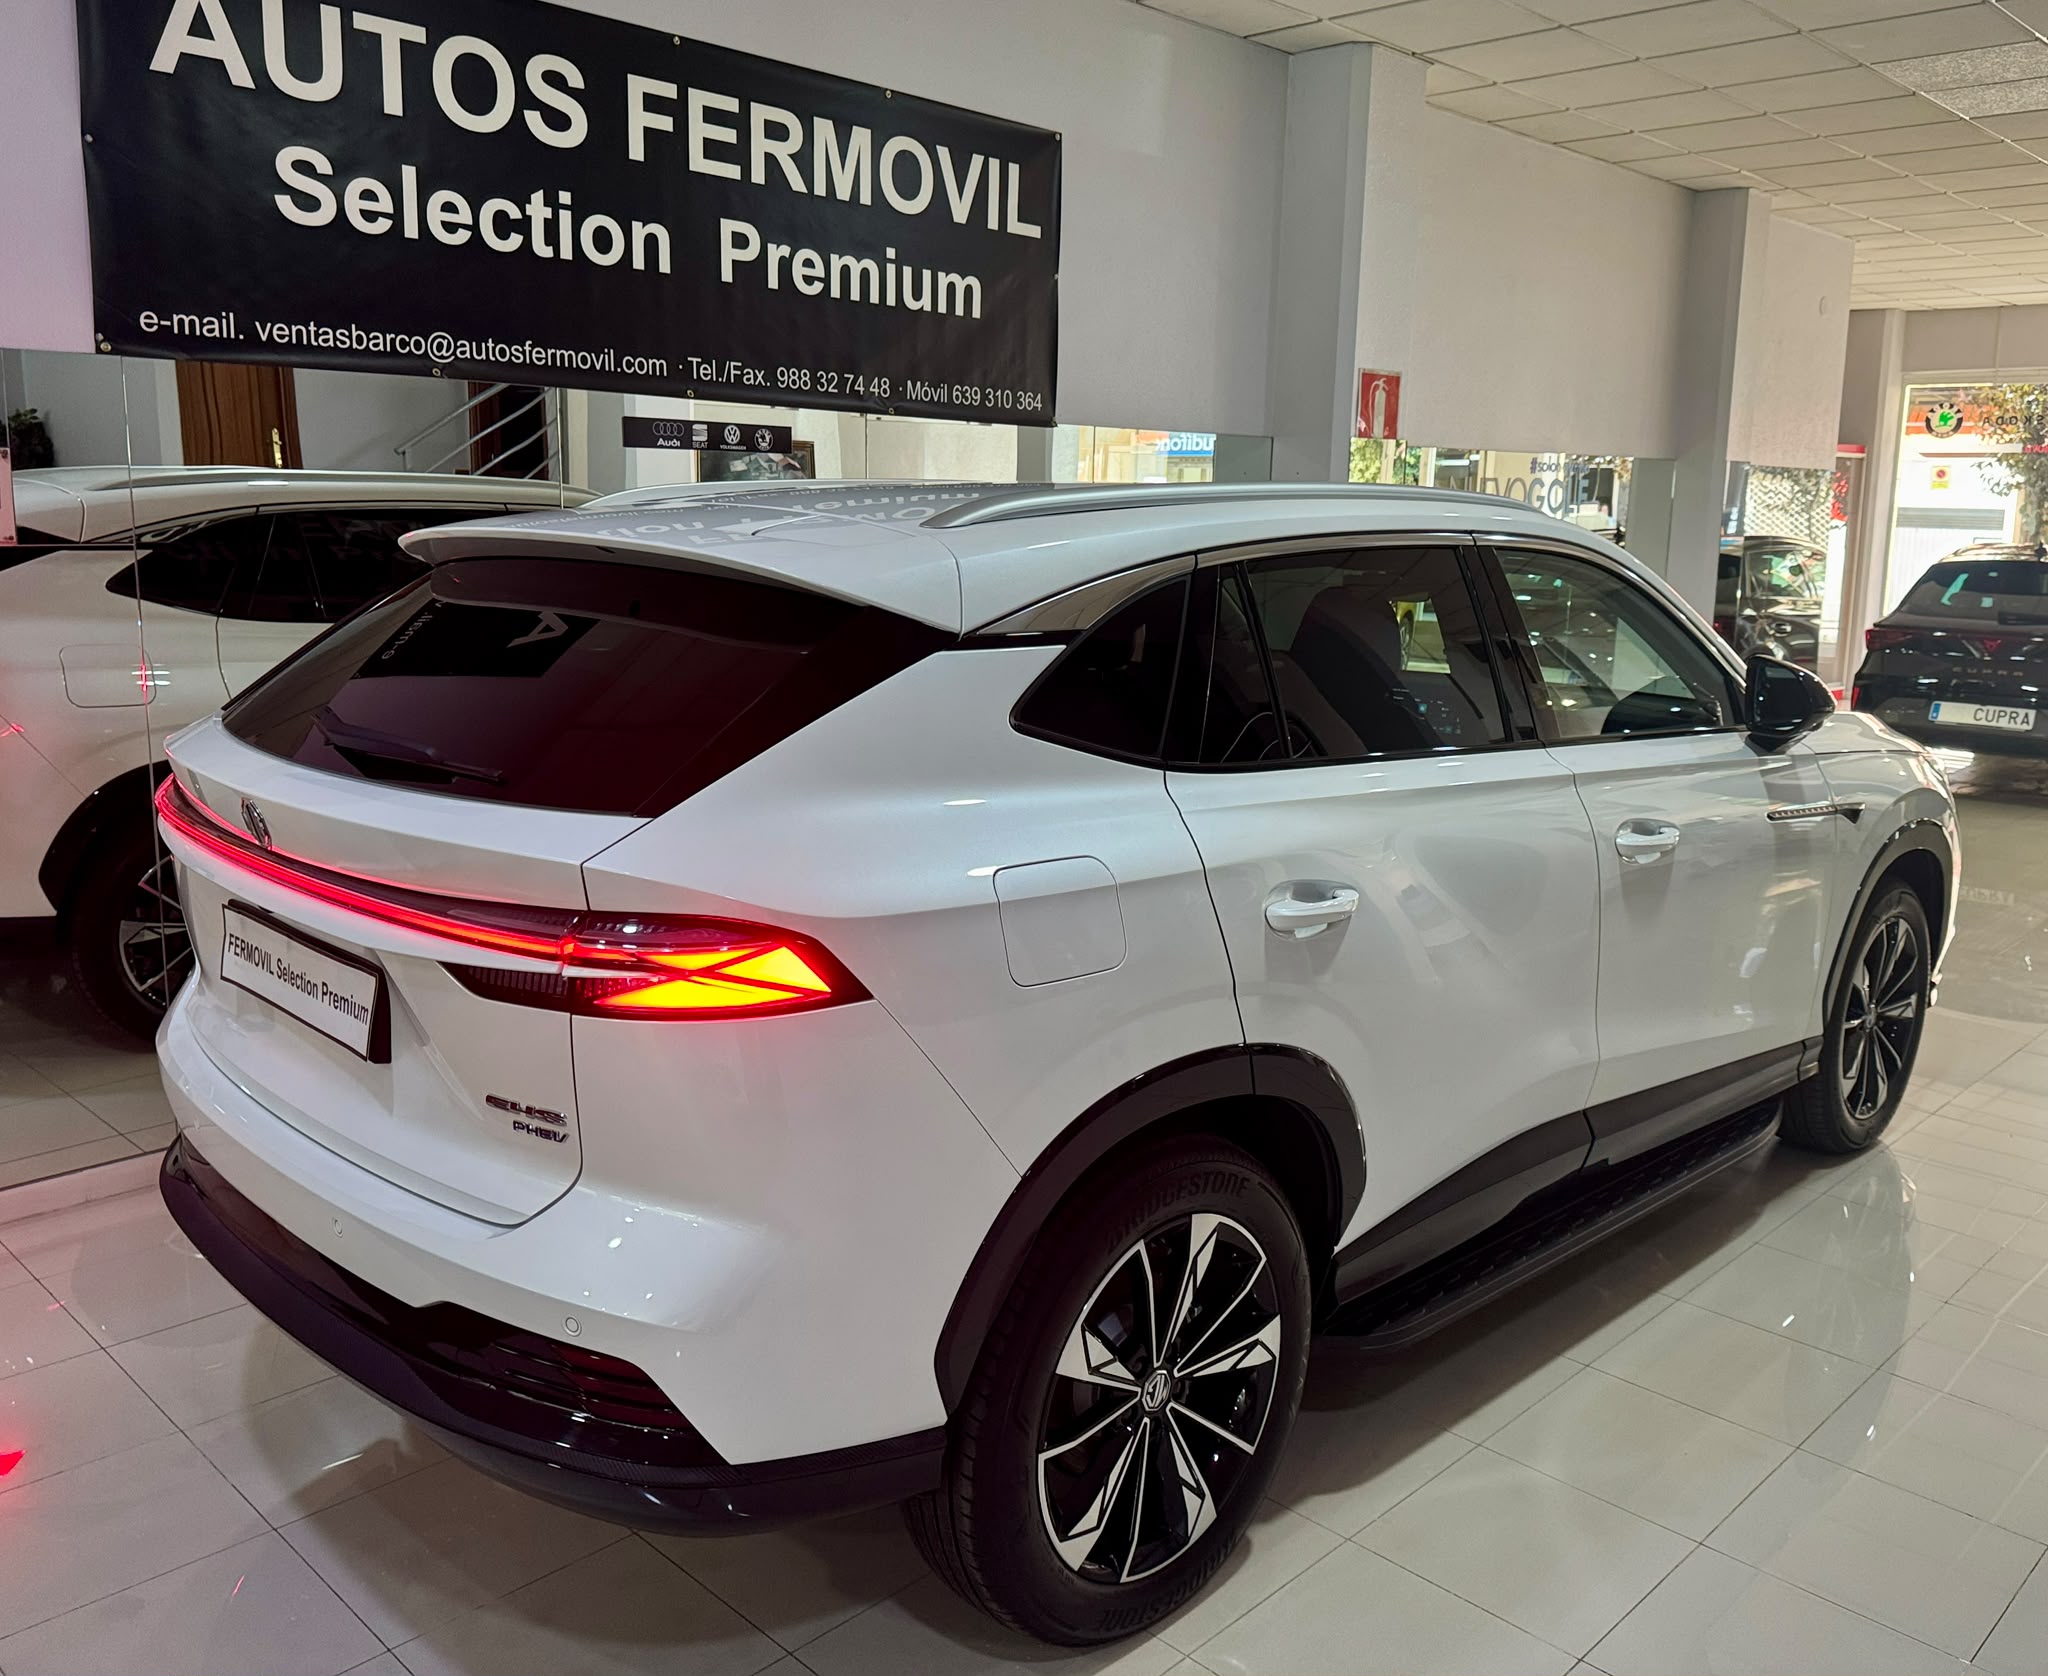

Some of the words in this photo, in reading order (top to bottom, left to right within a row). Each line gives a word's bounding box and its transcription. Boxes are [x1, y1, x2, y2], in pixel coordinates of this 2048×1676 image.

[149, 0, 588, 149] AUTOS
[626, 73, 1042, 239] FERMOVIL
[273, 145, 671, 274] Selection
[719, 217, 982, 319] Premium
[139, 310, 244, 340] e-mail.
[254, 320, 667, 377] ventasbarco@autosfermovil.com
[687, 356, 771, 387] Tel./Fax.
[776, 366, 811, 391] 988
[816, 370, 839, 393] 32
[844, 373, 865, 396] 74
[869, 376, 891, 398] 48
[906, 379, 948, 403] Móvil
[952, 384, 981, 406] 639
[985, 387, 1013, 409] 310
[1016, 390, 1043, 412] 364
[657, 438, 680, 447] Audi
[1973, 707, 2030, 727] CUPRA
[228, 933, 274, 976] FERMOVIL
[276, 958, 319, 1000] Selection
[321, 981, 370, 1026] Premium
[513, 1120, 570, 1143] PHEV
